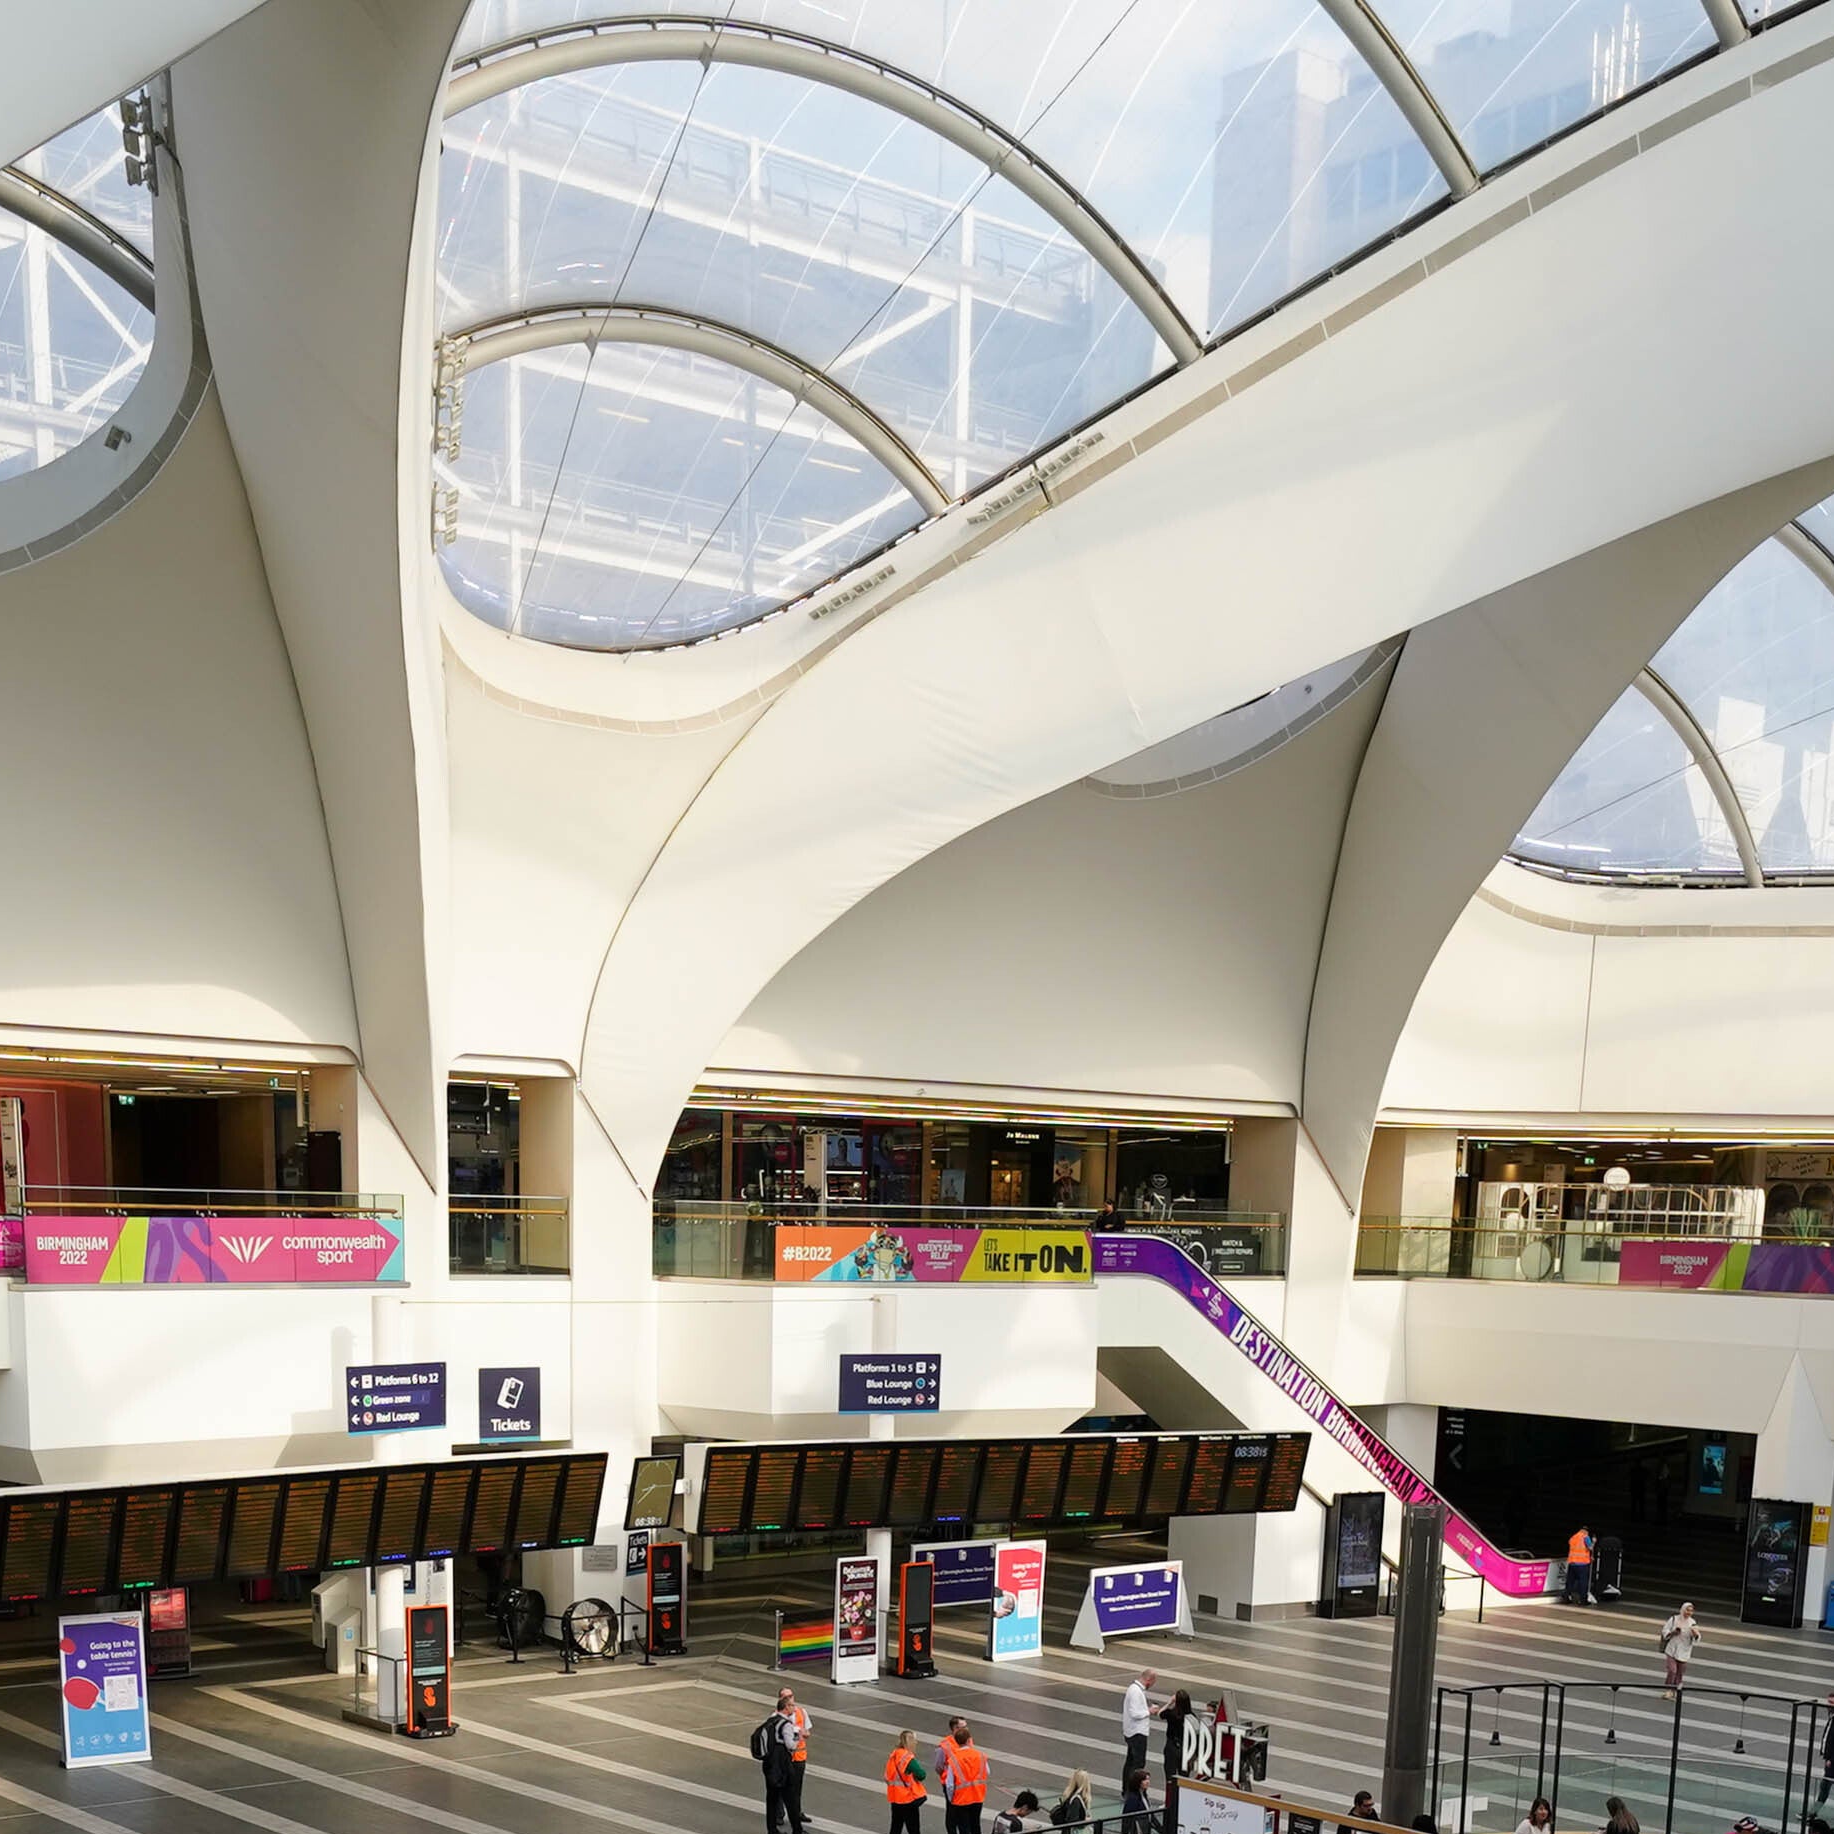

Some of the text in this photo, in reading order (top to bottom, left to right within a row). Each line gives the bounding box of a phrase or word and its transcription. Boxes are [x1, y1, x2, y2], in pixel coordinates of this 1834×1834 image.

[36, 1236, 109, 1251] BIRMINGHAM
[282, 1234, 386, 1251] commonwealth
[983, 1238, 998, 1251] LET'S
[59, 1250, 88, 1265] 2022
[317, 1249, 354, 1266] sport
[782, 1245, 832, 1262] #B2022
[1659, 1255, 1709, 1266] BIRMINGHAM
[983, 1252, 1014, 1273] TAKE
[1014, 1253, 1038, 1272] IT
[1673, 1264, 1693, 1276] 2022
[853, 1363, 889, 1373] Platforms
[897, 1363, 907, 1373] to
[1229, 1313, 1327, 1422] DESTINATION
[375, 1374, 411, 1387] Platforms
[419, 1374, 428, 1384] to
[428, 1372, 440, 1384] 12
[866, 1379, 912, 1390] Blue Lounge
[867, 1394, 912, 1406] Red Lounge
[375, 1411, 420, 1424] Red Lounge
[490, 1418, 532, 1432] Tickets
[629, 1534, 649, 1548] Tickets
[90, 1640, 136, 1652] Going to the
[90, 1649, 137, 1661] table tennis?
[1181, 1714, 1247, 1784] PRET
